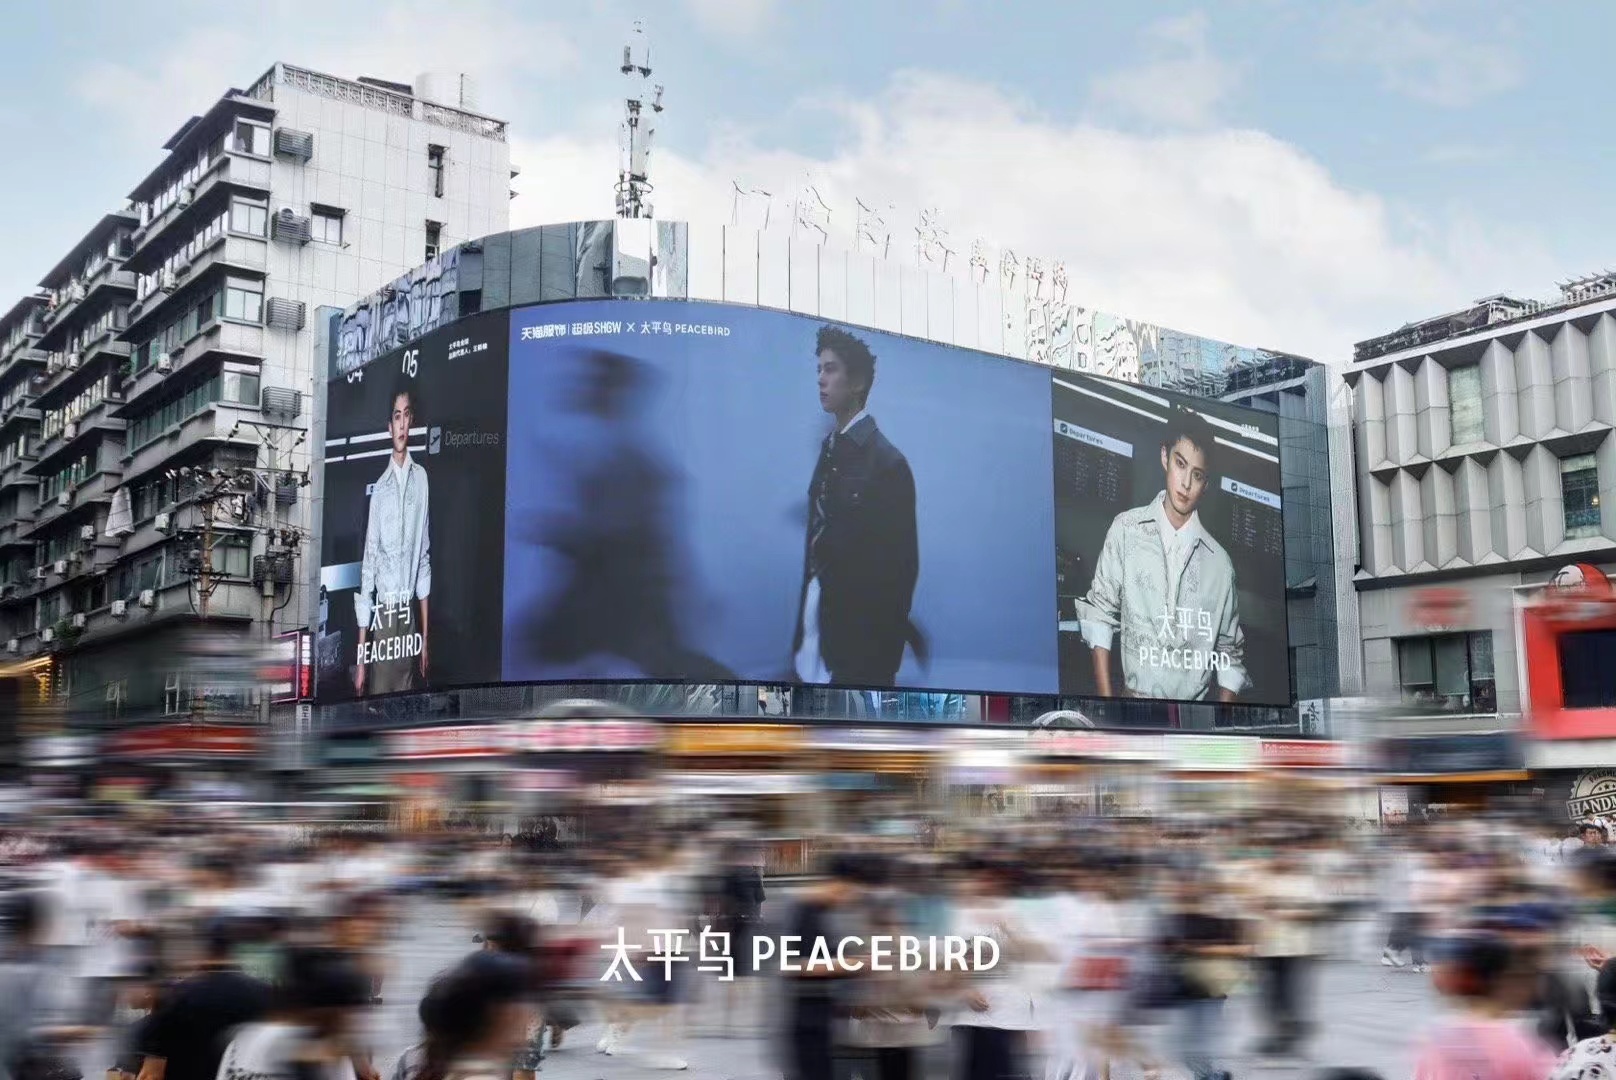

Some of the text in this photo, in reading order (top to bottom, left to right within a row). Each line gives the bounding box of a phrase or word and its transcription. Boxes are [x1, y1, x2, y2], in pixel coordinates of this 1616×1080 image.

[641, 321, 672, 335] 太平鸟
[675, 323, 731, 337] PEACEBIRD
[445, 430, 499, 448] Departures
[370, 590, 411, 632] 太平鸟
[1152, 604, 1212, 642] 太平鸟
[357, 633, 422, 665] PEACEBIRD
[1139, 646, 1231, 671] PEACEBIRD
